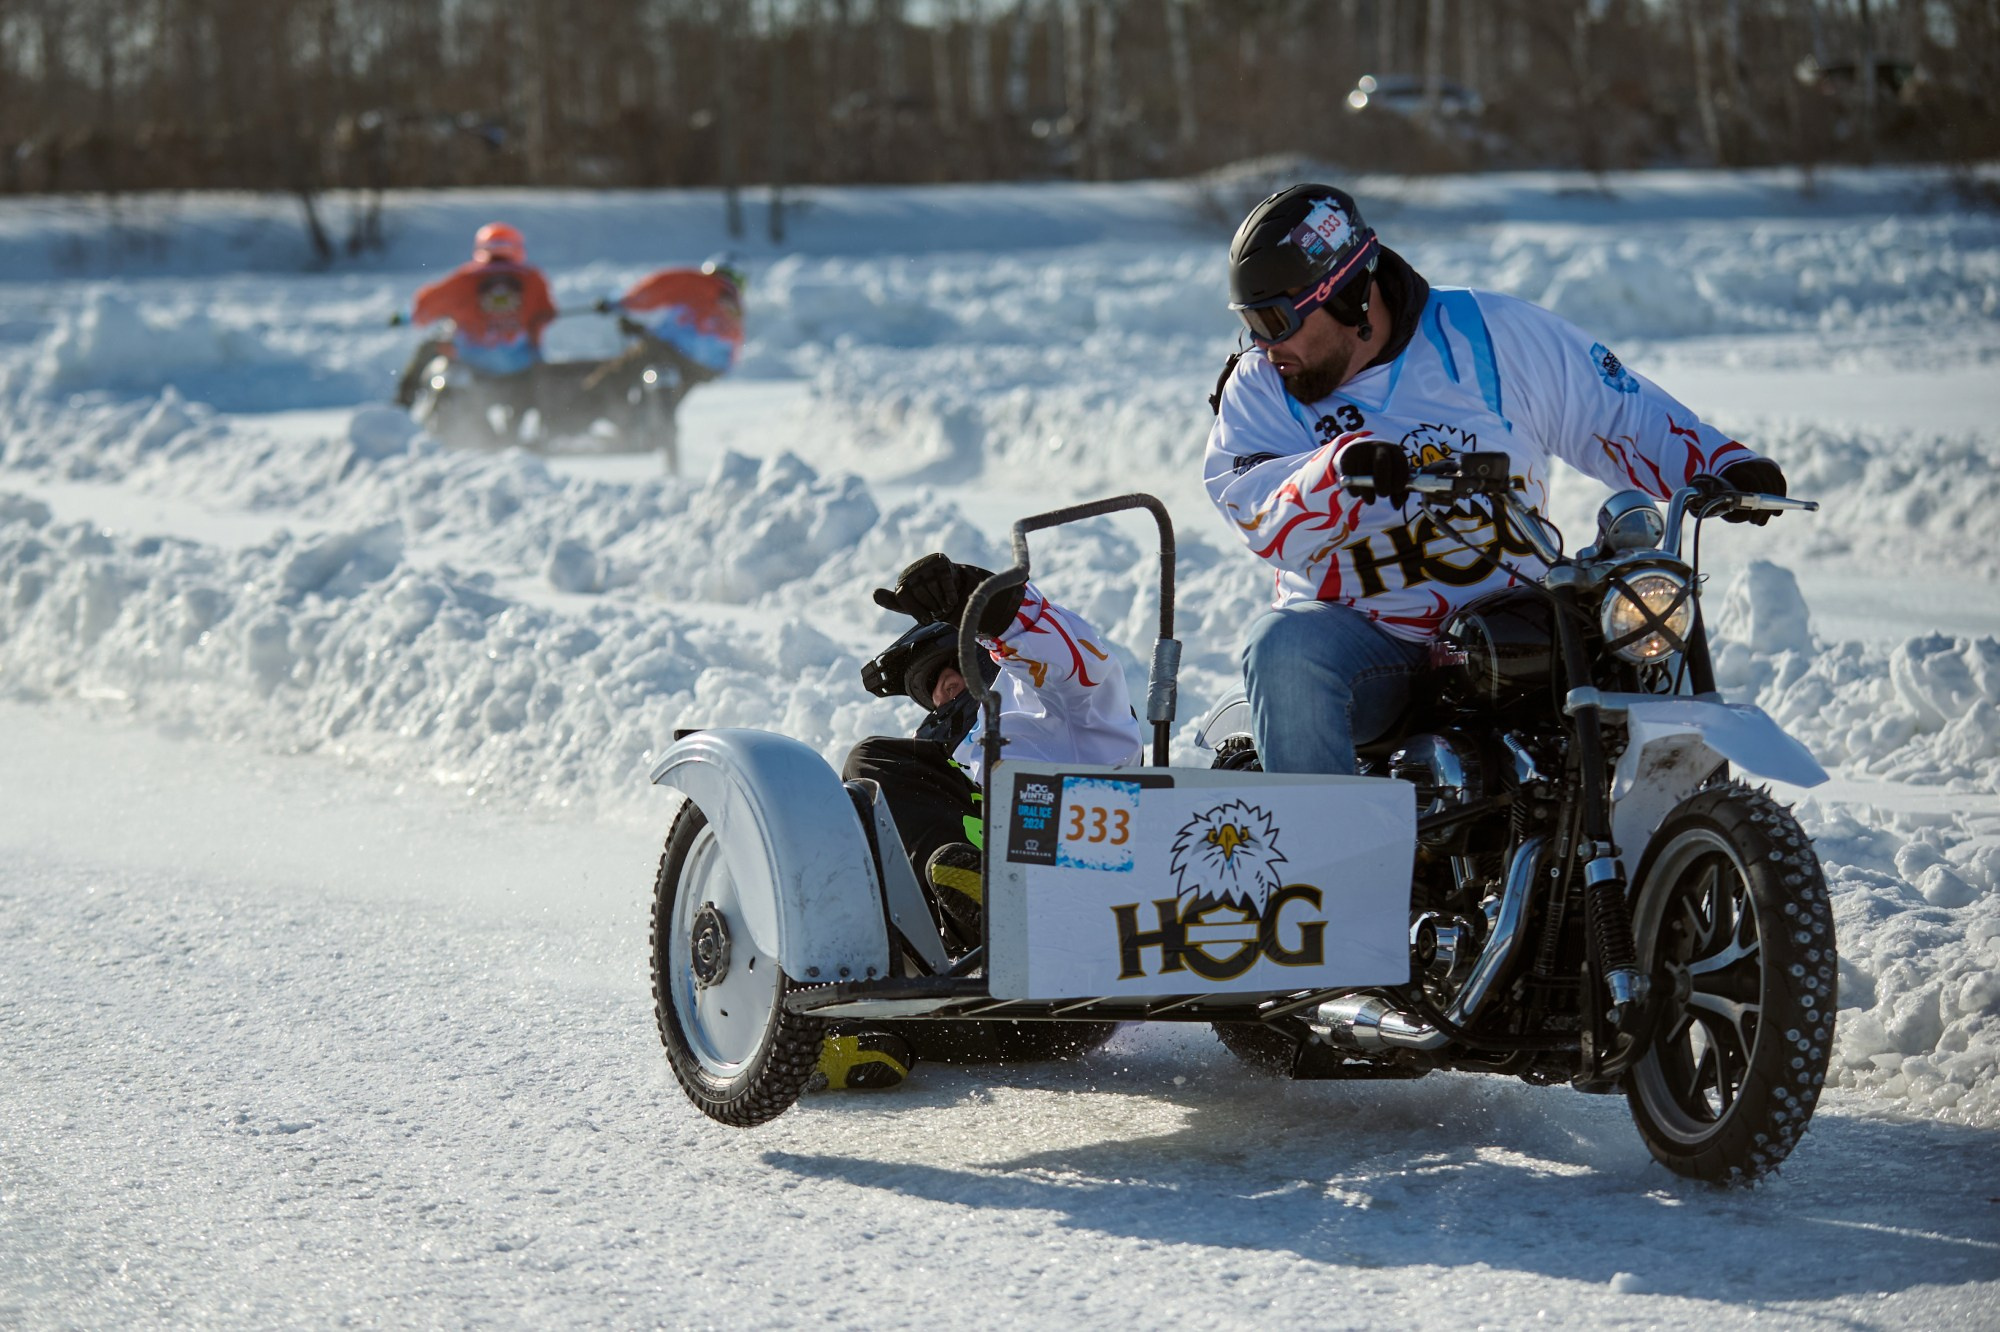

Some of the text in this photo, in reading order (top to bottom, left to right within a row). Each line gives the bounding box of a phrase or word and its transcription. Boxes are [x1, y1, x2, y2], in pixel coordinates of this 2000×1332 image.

[1317, 214, 1341, 238] 333
[1019, 790, 1055, 803] WINTER
[1026, 783, 1048, 793] HOG
[1023, 818, 1045, 829] 2024
[1064, 804, 1131, 846] 333
[1109, 883, 1329, 982] HOG
